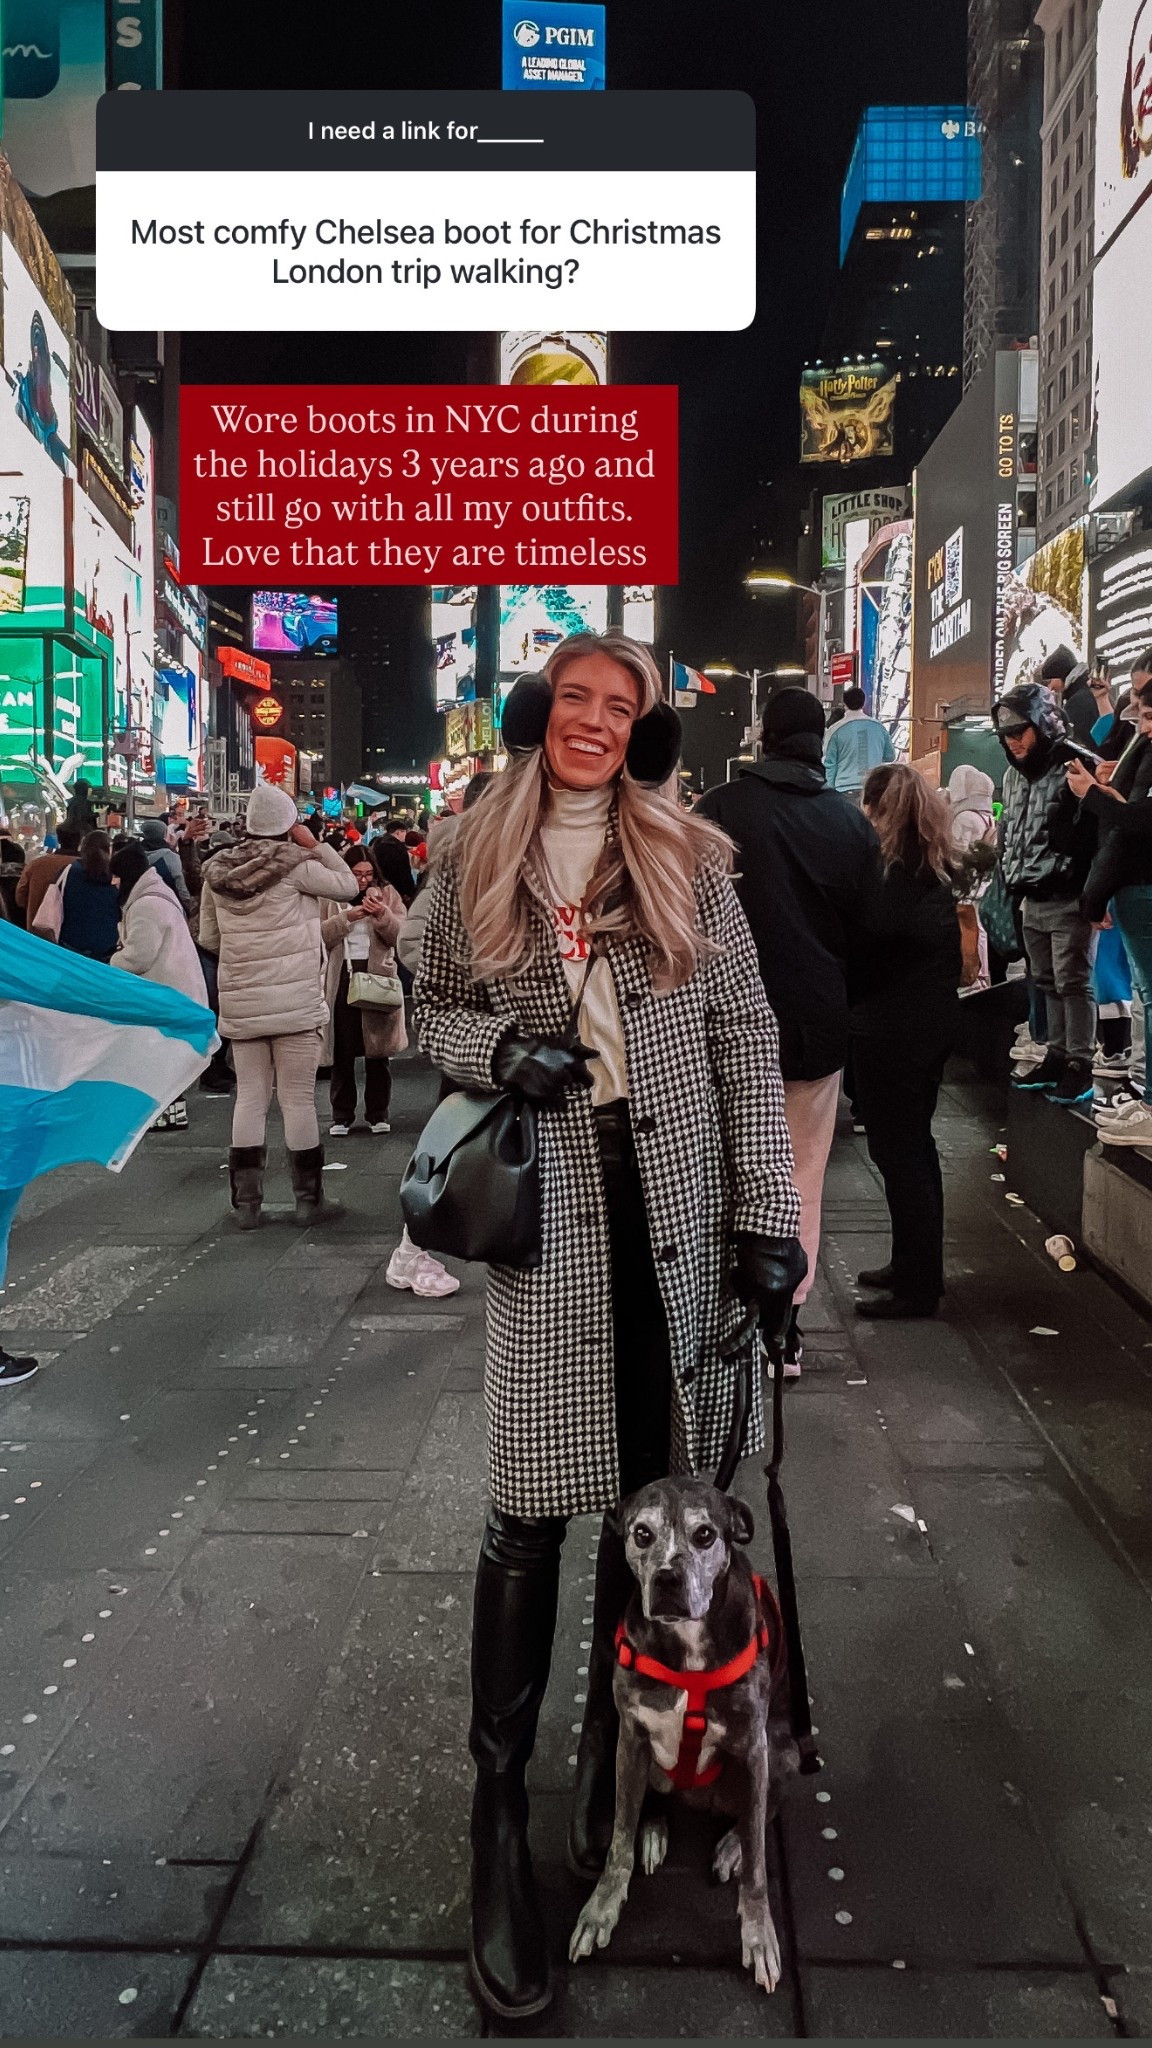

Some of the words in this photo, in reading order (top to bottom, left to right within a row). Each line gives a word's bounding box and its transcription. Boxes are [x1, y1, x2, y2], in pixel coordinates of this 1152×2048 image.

[545, 27, 594, 47] PGIM
[524, 68, 547, 80] ASSET
[819, 377, 848, 400] Harry
[847, 374, 879, 397] Potter
[998, 435, 1014, 455] TO
[998, 457, 1014, 478] GO
[831, 493, 870, 519] LITTLE
[873, 493, 903, 513] SHOP
[997, 503, 1013, 558] SCREEN
[931, 583, 945, 622] THE
